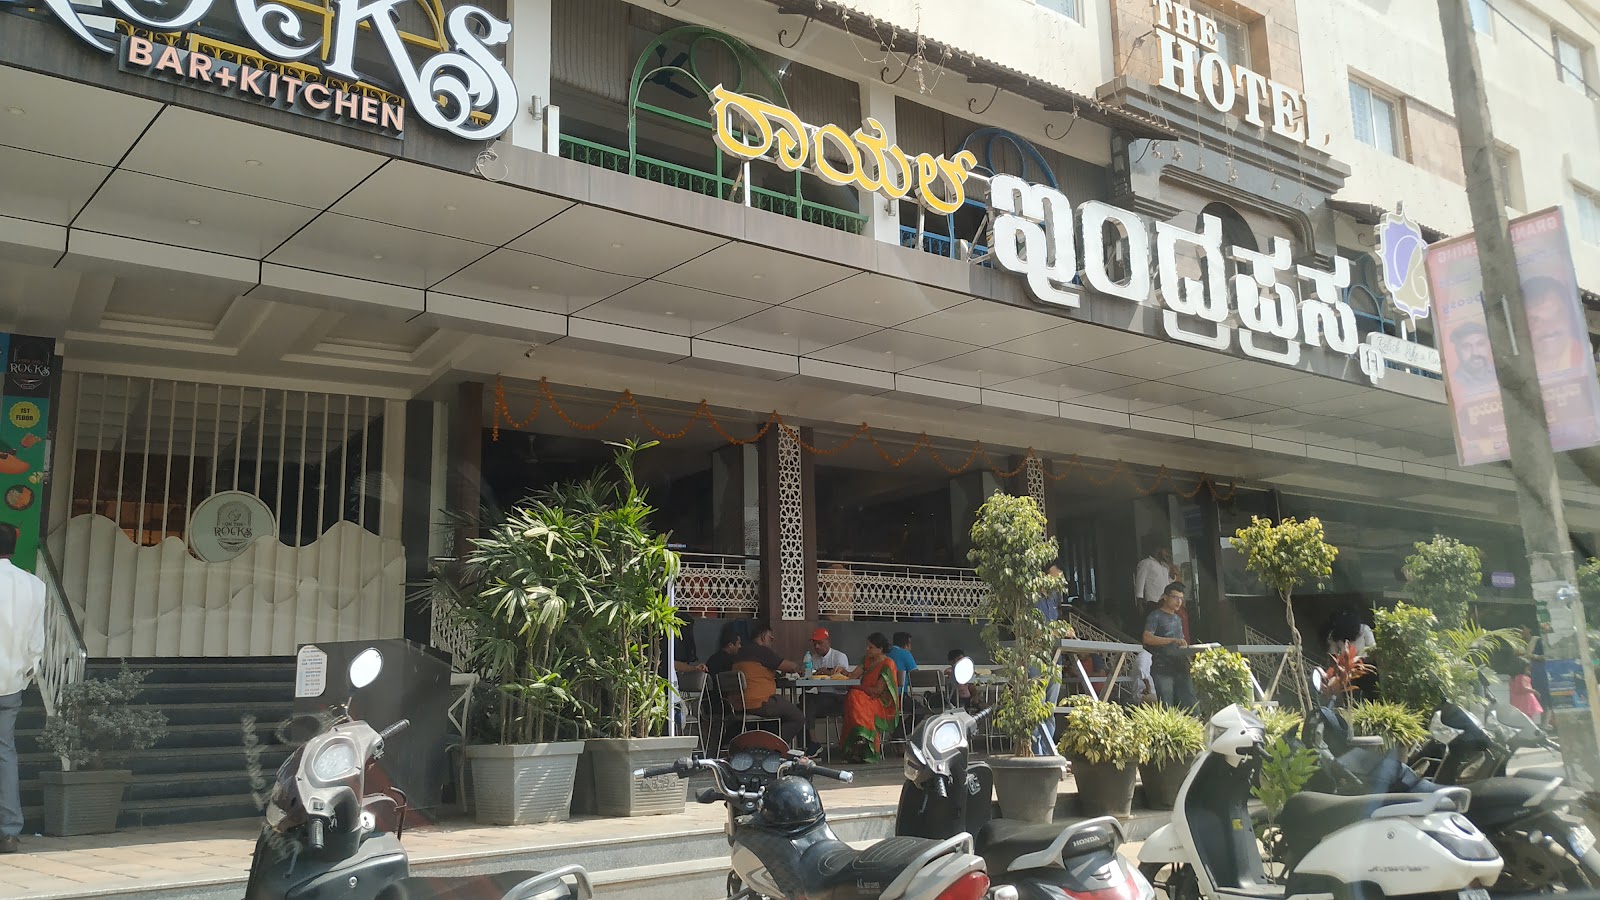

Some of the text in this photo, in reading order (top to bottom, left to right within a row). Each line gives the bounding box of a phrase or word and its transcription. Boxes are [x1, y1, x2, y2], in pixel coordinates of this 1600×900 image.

[1154, 0, 1219, 52] THE
[127, 36, 405, 132] BAR+KITCHEN
[1156, 28, 1331, 149] HOTEL
[709, 83, 1385, 385] ರಾಯಲ್ ಇಂದ್ರಪ್ರಸ್ಥ
[10, 362, 50, 377] ROCKS
[213, 526, 253, 539] ROCKS
[1072, 835, 1100, 847] HONDA
